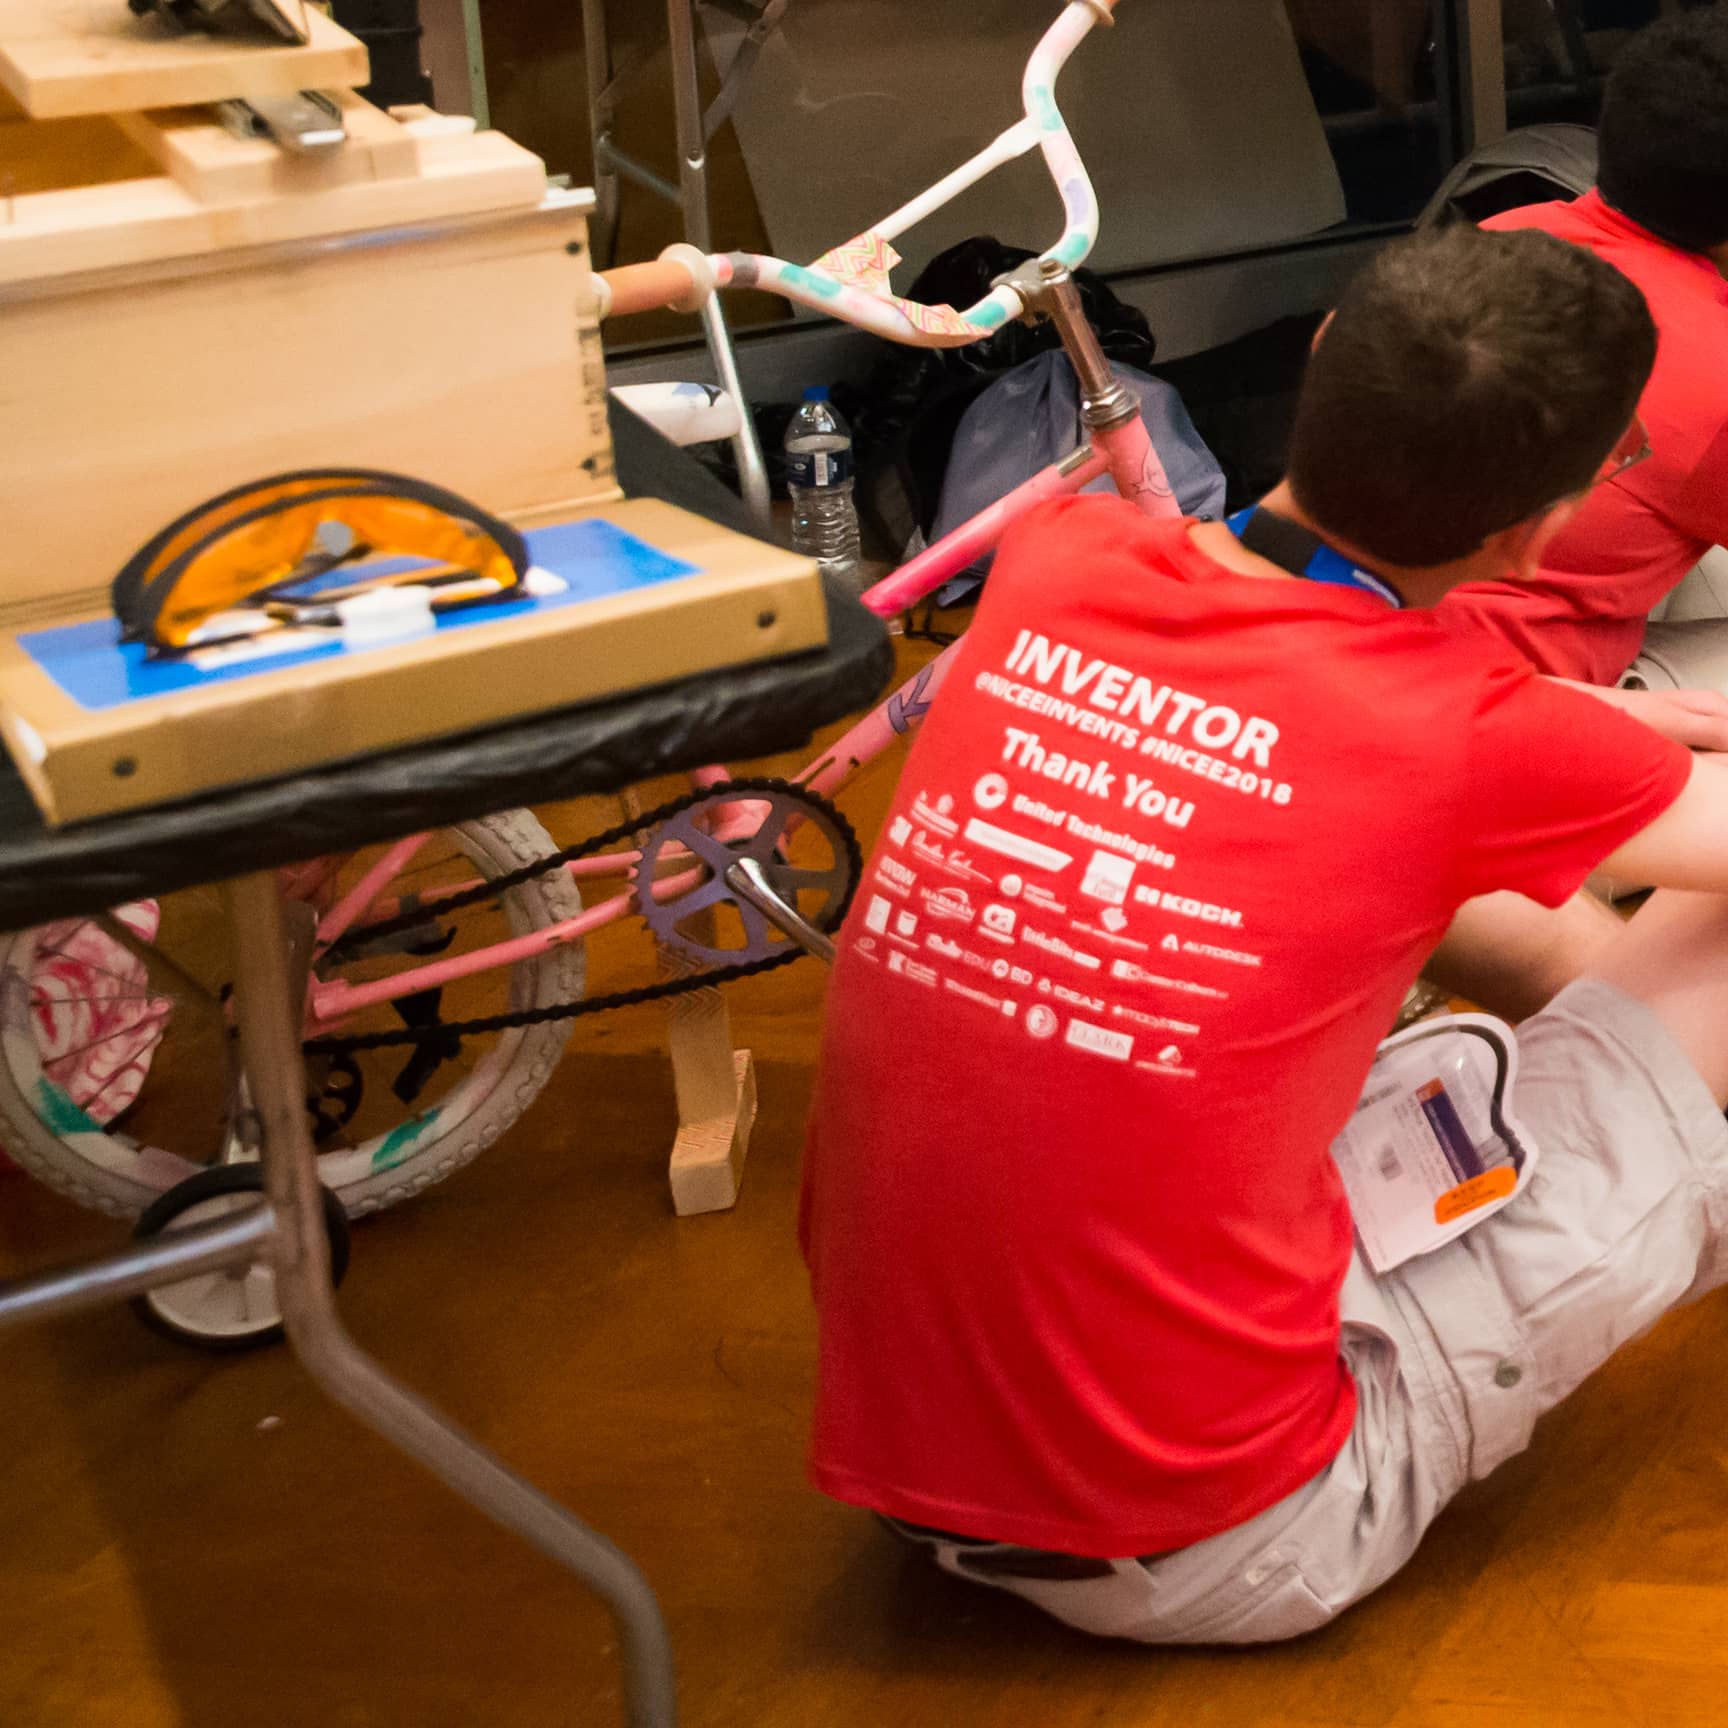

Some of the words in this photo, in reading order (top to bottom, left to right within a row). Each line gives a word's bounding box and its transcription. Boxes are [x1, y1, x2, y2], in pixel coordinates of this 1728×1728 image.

[974, 671, 1140, 749] @NICEEINVENTS
[1139, 733, 1293, 805] #NICEE2018
[1004, 629, 1280, 768] INVENTOR
[1000, 726, 1111, 800] Thank
[1121, 775, 1196, 828] You
[1012, 793, 1068, 828] United
